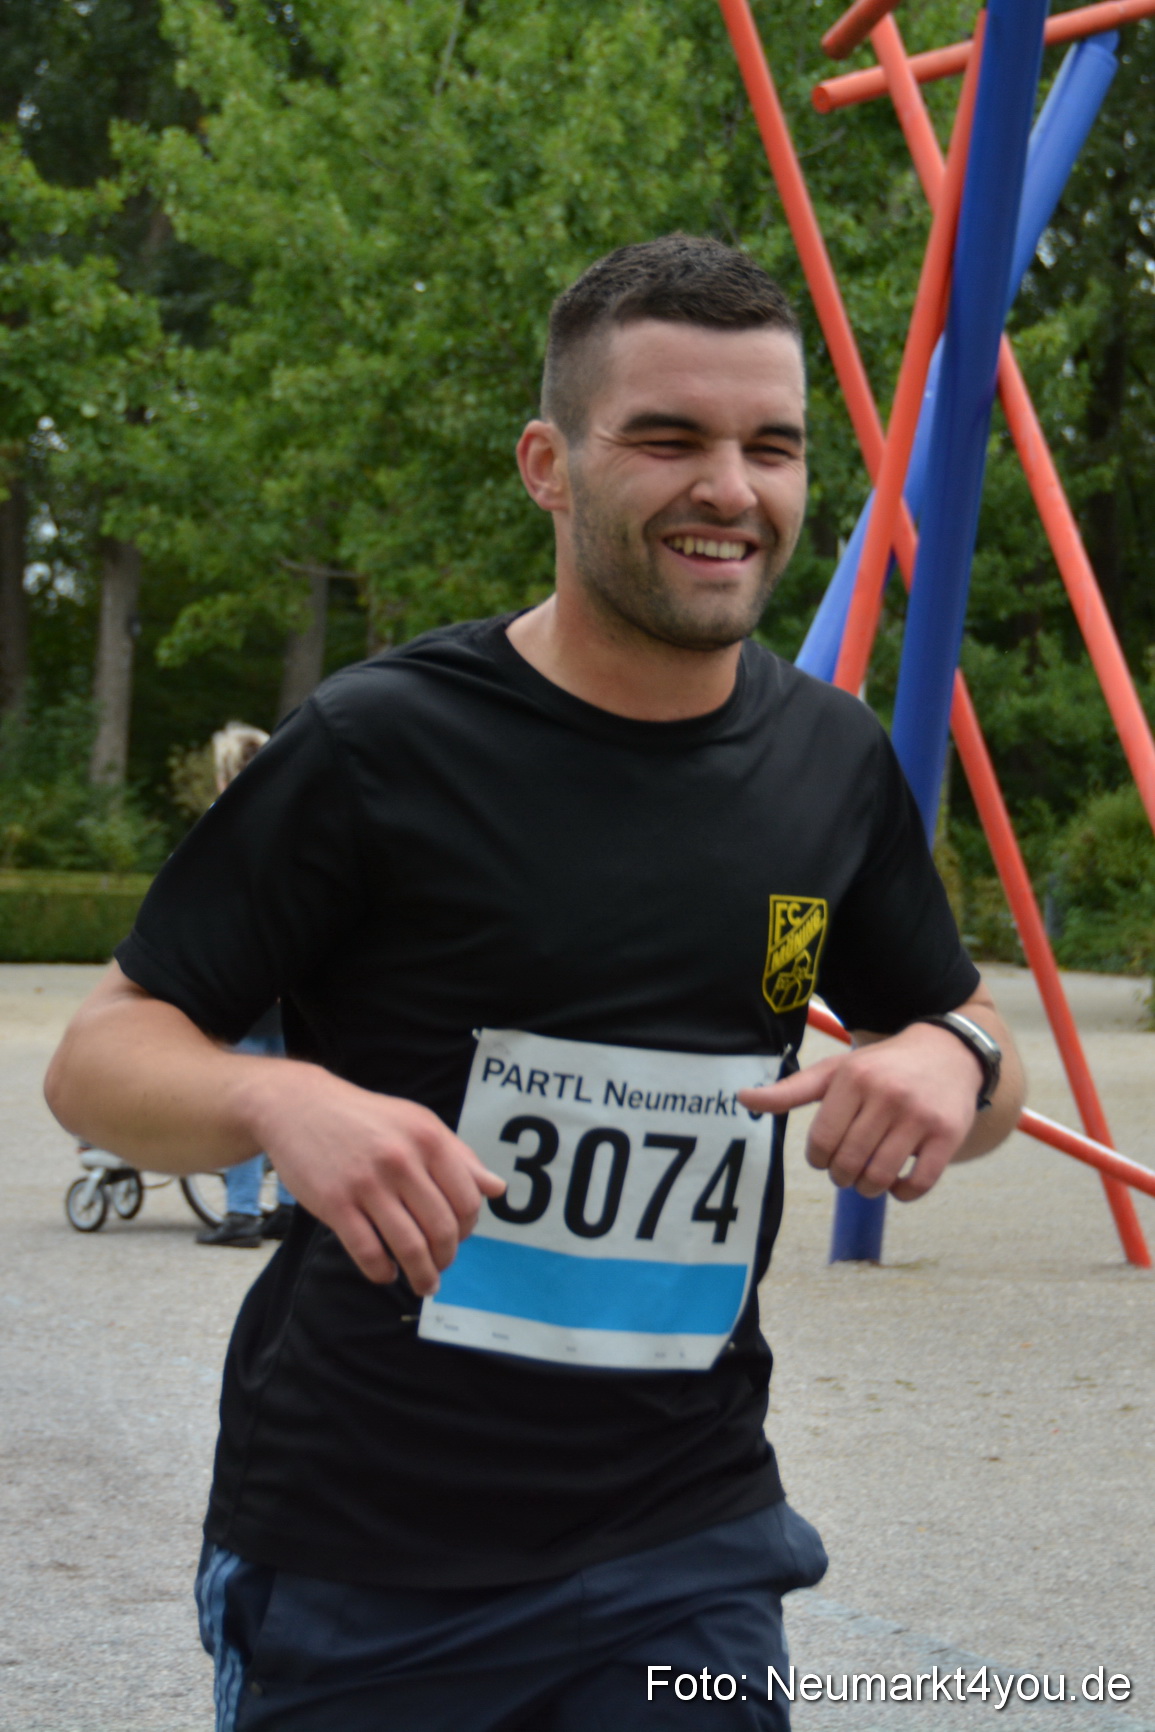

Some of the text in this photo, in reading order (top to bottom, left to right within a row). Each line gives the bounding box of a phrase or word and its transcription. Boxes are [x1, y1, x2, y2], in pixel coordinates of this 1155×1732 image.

[774, 901, 802, 946] FC
[481, 1056, 593, 1103] PARTL
[603, 1079, 738, 1117] Neumarkt
[487, 1113, 748, 1245] 3074
